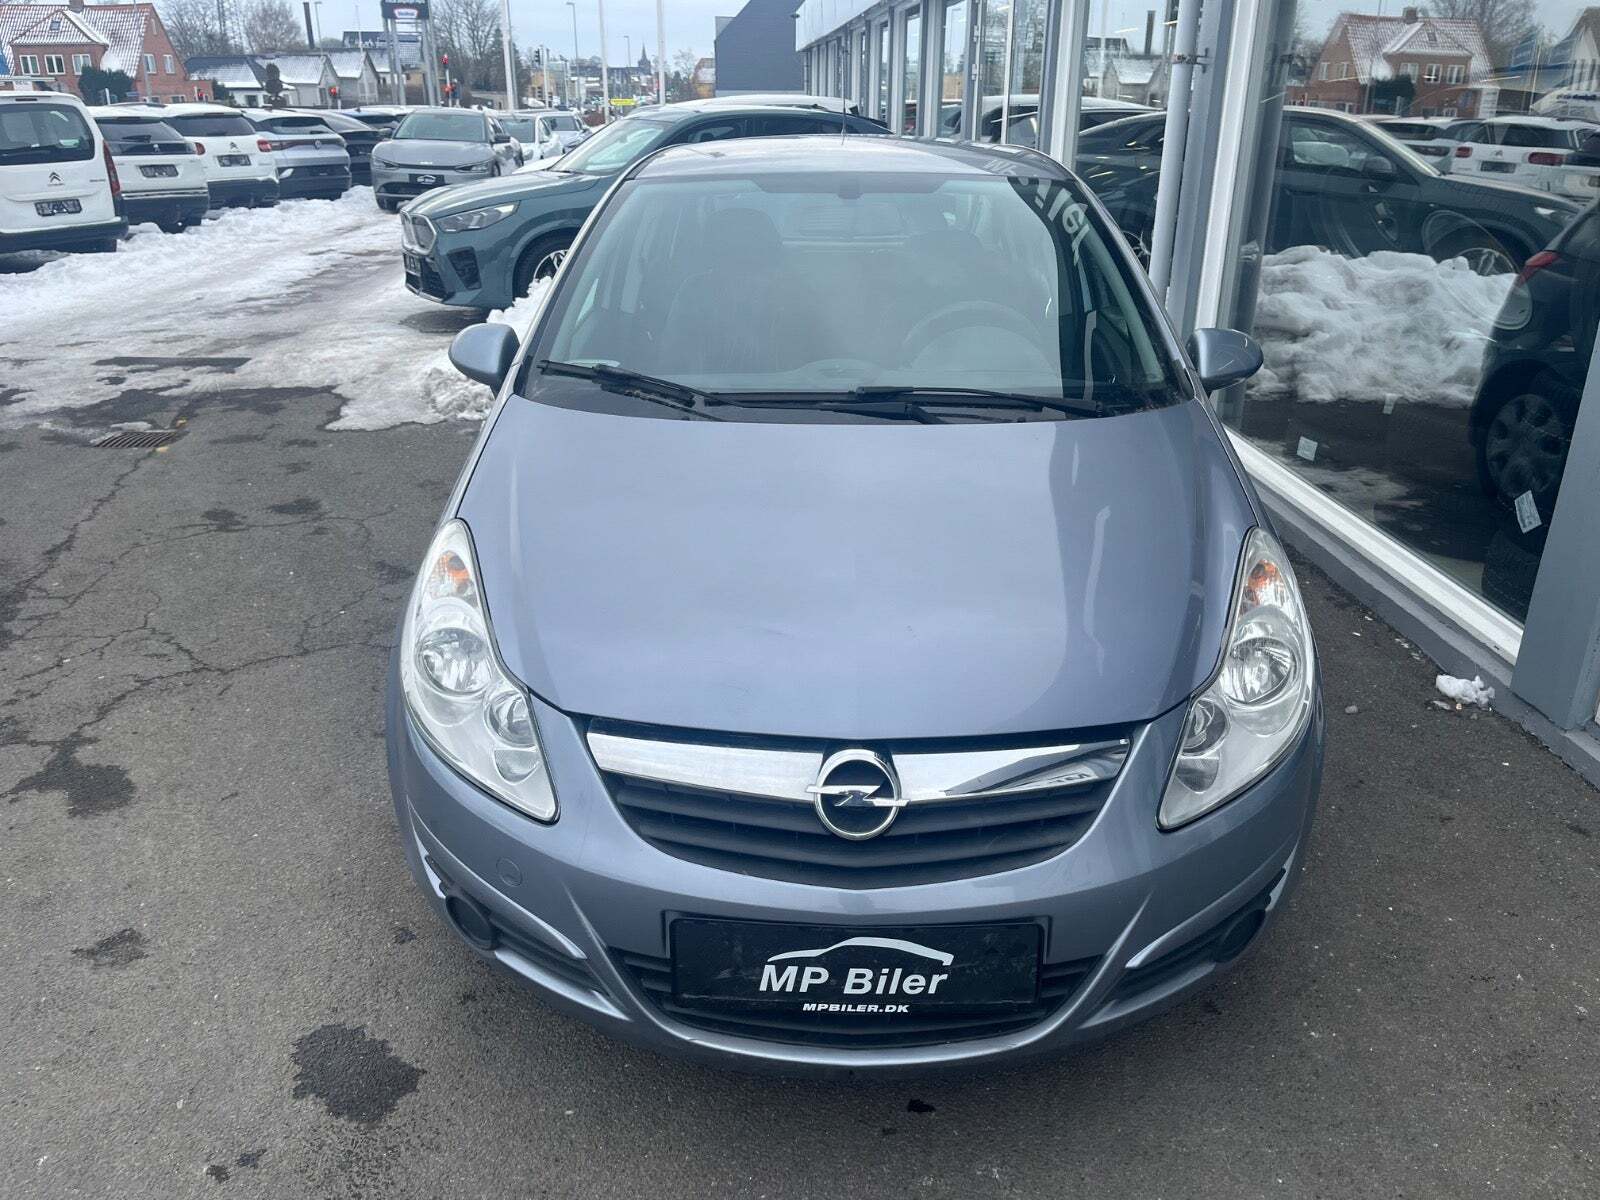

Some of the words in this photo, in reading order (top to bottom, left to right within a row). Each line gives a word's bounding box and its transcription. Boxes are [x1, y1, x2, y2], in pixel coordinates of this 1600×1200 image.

[759, 965, 829, 993] MP
[844, 968, 948, 995] Biler
[803, 1003, 909, 1013] MPBILER.DK
